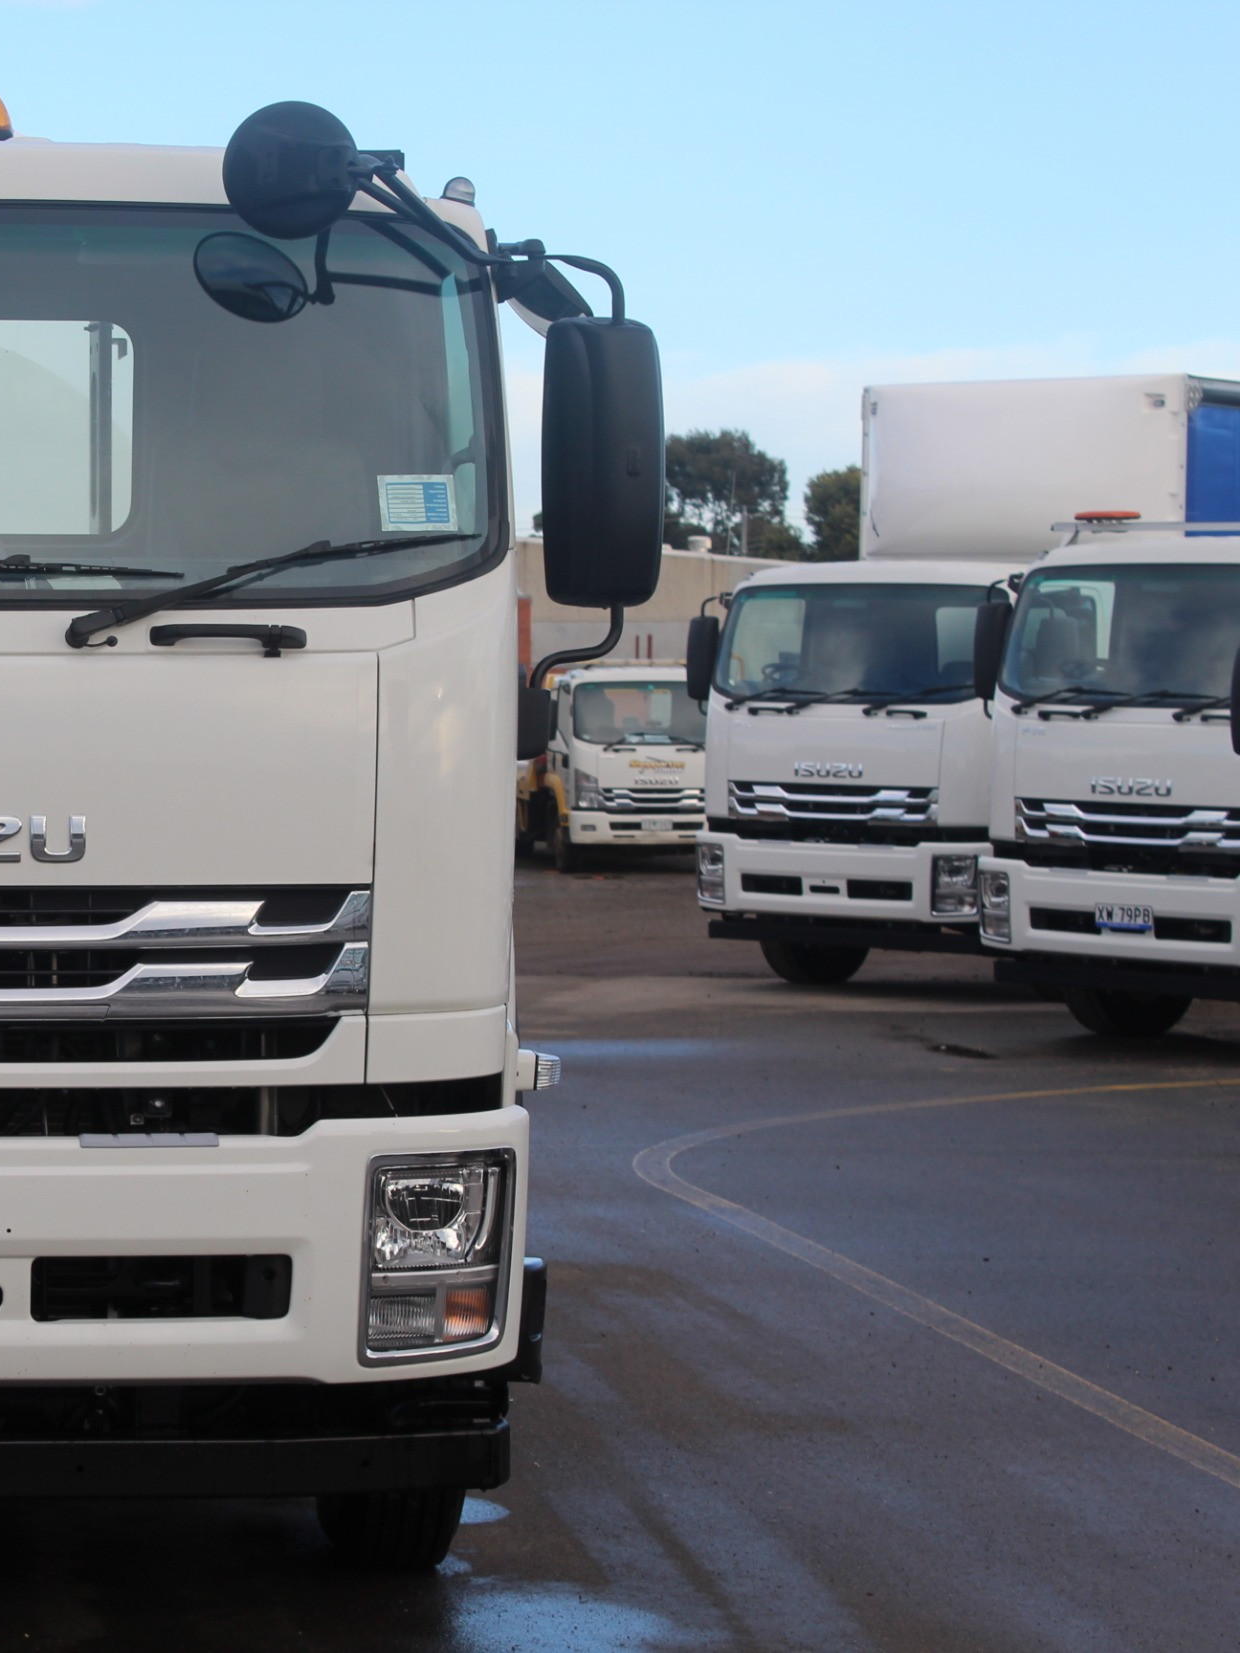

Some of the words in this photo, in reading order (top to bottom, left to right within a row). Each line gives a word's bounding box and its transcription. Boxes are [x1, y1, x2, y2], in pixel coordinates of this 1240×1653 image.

[794, 761, 864, 779] ISUZU
[634, 776, 679, 786] ISUZU
[1091, 776, 1173, 798] ISUZU
